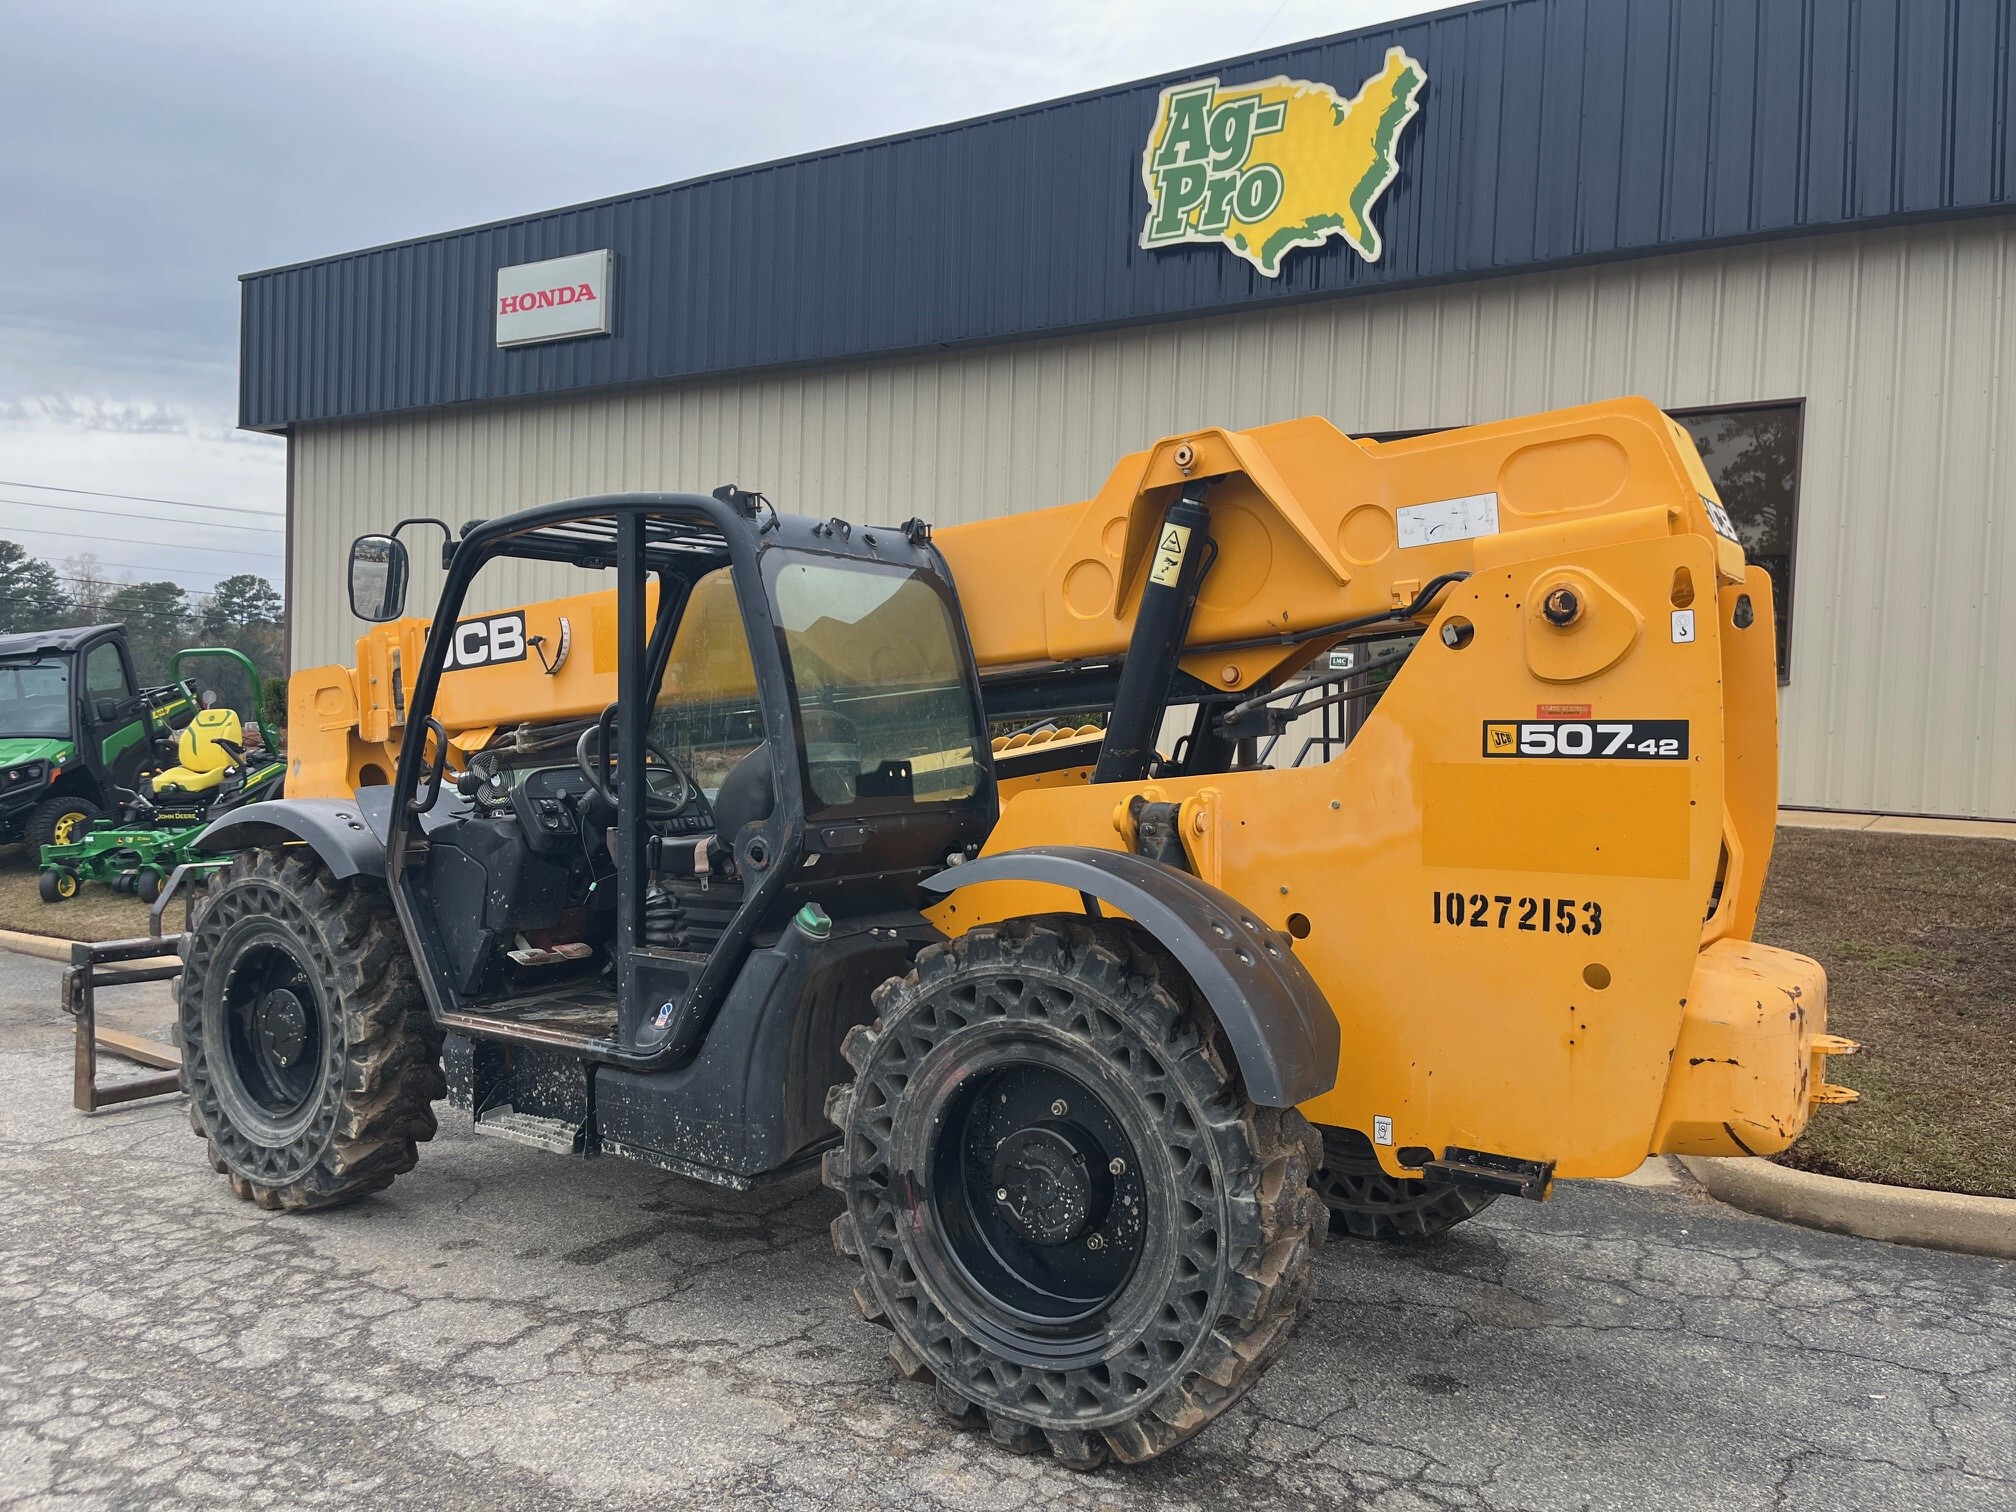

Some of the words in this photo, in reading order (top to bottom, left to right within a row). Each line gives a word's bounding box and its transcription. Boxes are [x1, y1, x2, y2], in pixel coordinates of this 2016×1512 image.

[1153, 86, 1287, 173] Ag-
[1149, 162, 1284, 240] Pro
[499, 283, 597, 315] HONDA
[1332, 657, 1347, 665] LMC
[1493, 731, 1513, 746] JCB
[1520, 724, 1679, 755] 507-42
[175, 812, 197, 820] DEERE
[1433, 891, 1602, 936] 10272153
